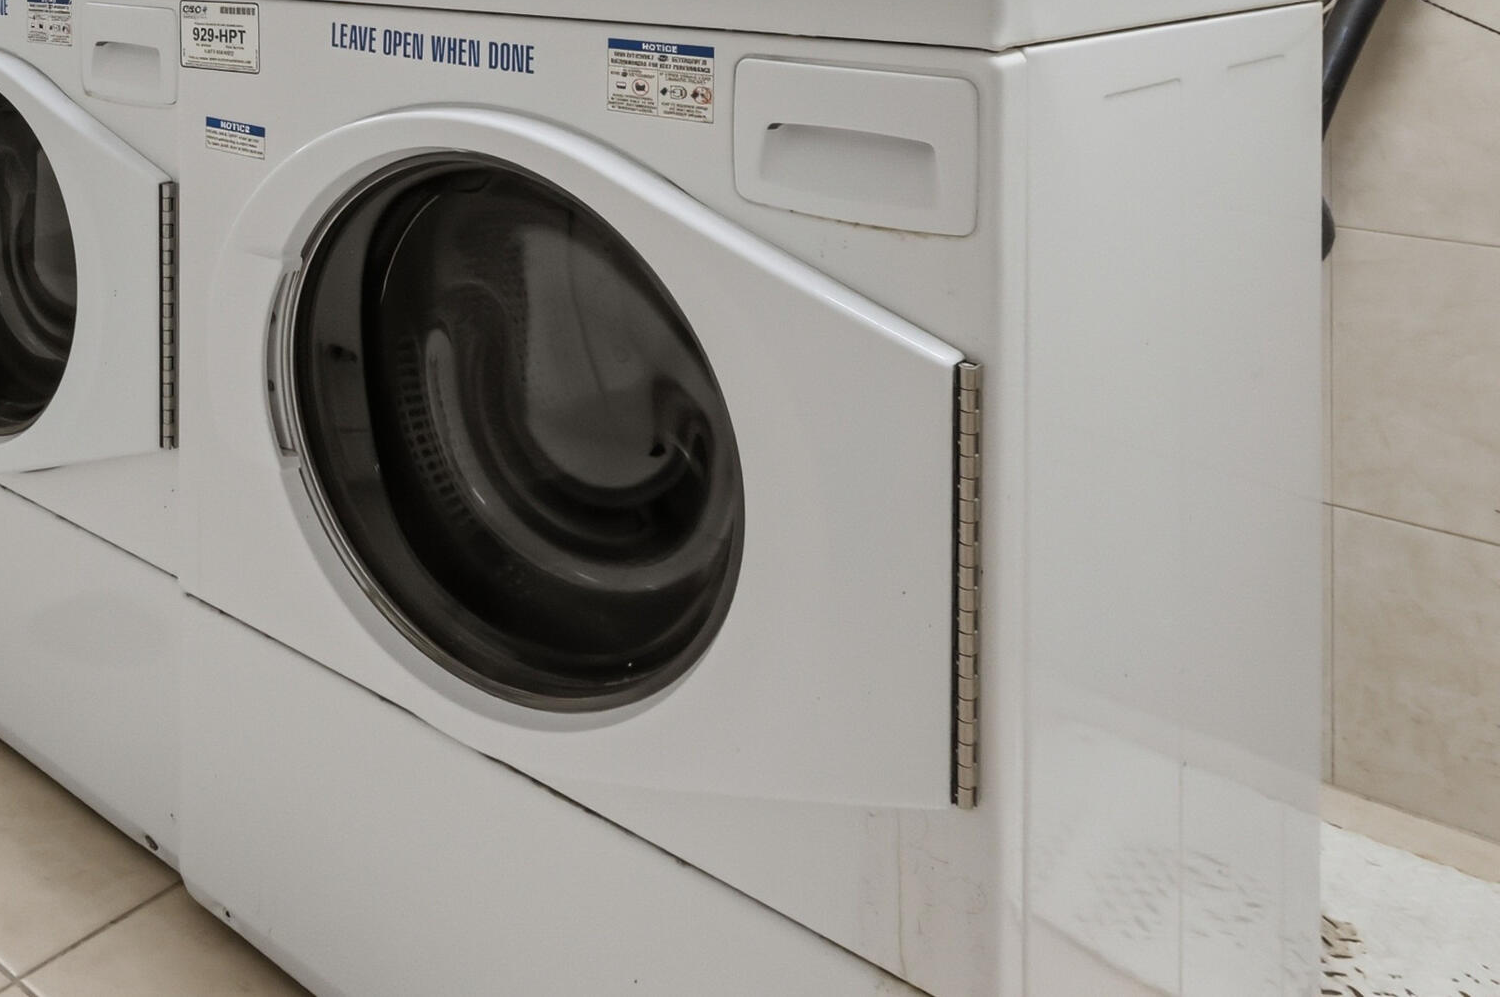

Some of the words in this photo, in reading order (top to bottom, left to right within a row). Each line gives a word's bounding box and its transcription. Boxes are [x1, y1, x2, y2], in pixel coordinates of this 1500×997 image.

[183, 5, 201, 14] CSC
[192, 27, 246, 44] 929-HPT
[331, 22, 377, 53] LEAVE
[383, 29, 424, 60] OPEN
[431, 35, 480, 67] WHEN
[488, 42, 535, 74] DONE
[642, 42, 678, 53] NOTICE
[220, 121, 250, 133] NOTICE
